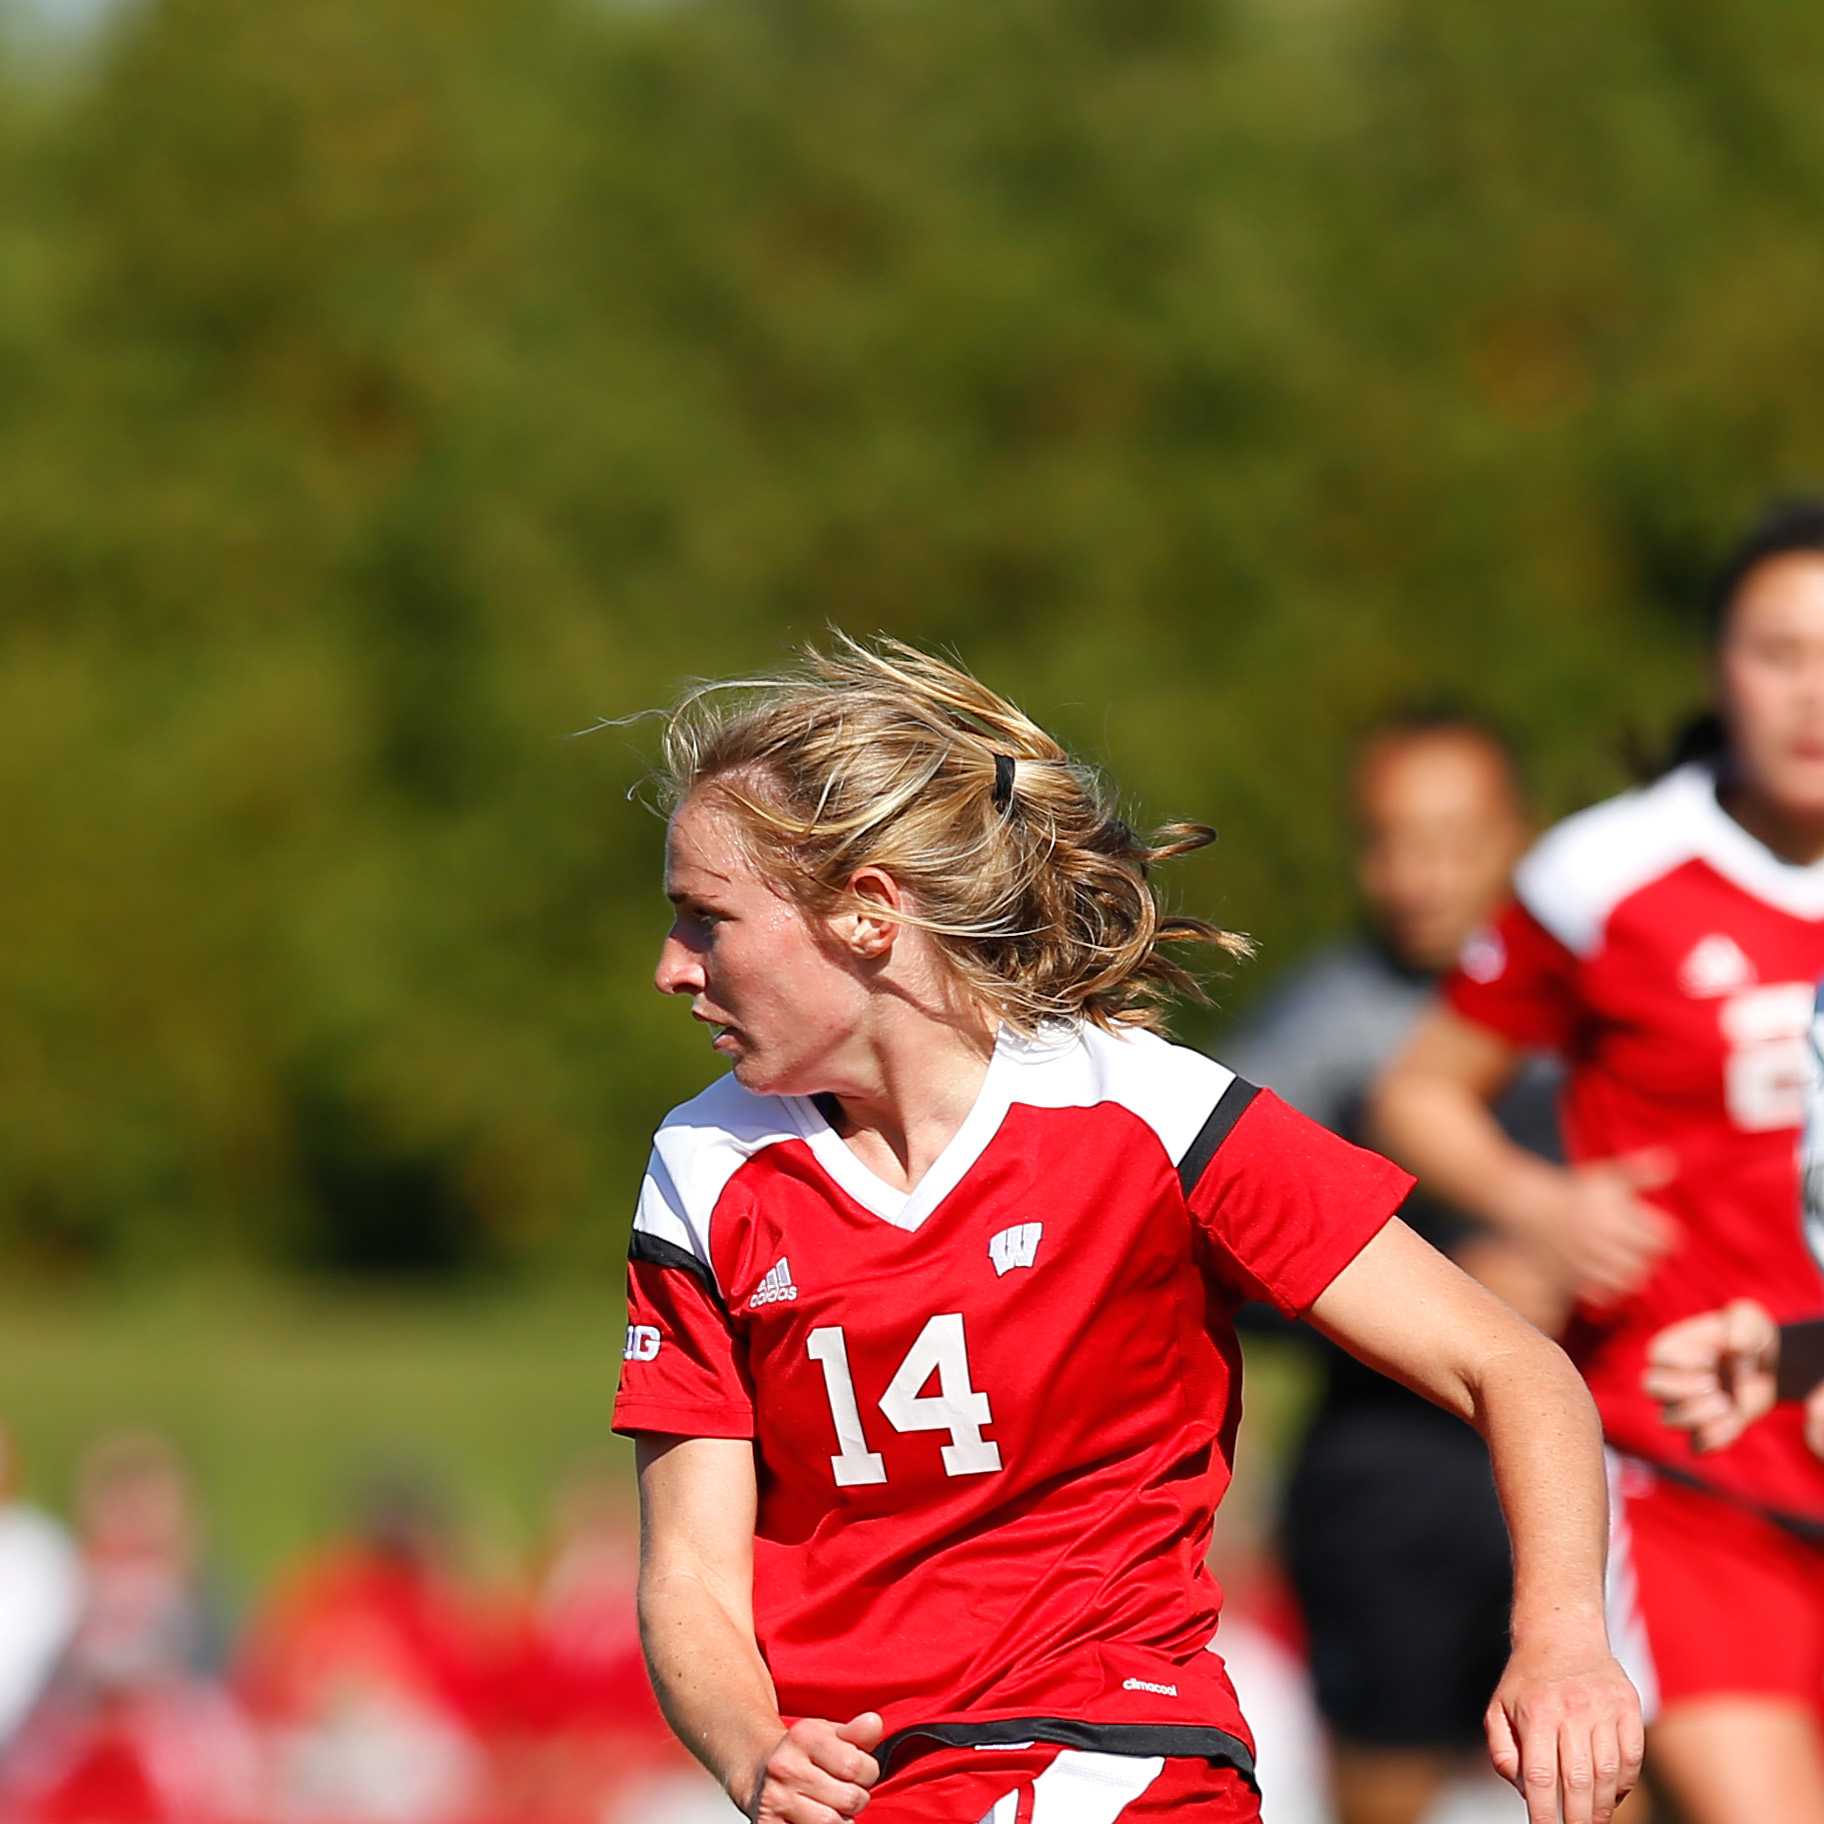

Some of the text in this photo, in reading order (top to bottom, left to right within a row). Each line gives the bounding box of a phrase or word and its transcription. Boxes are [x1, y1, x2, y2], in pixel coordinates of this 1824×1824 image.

[749, 1286, 798, 1308] adidas
[807, 1312, 1003, 1487] 14
[1122, 1678, 1178, 1697] climacool
